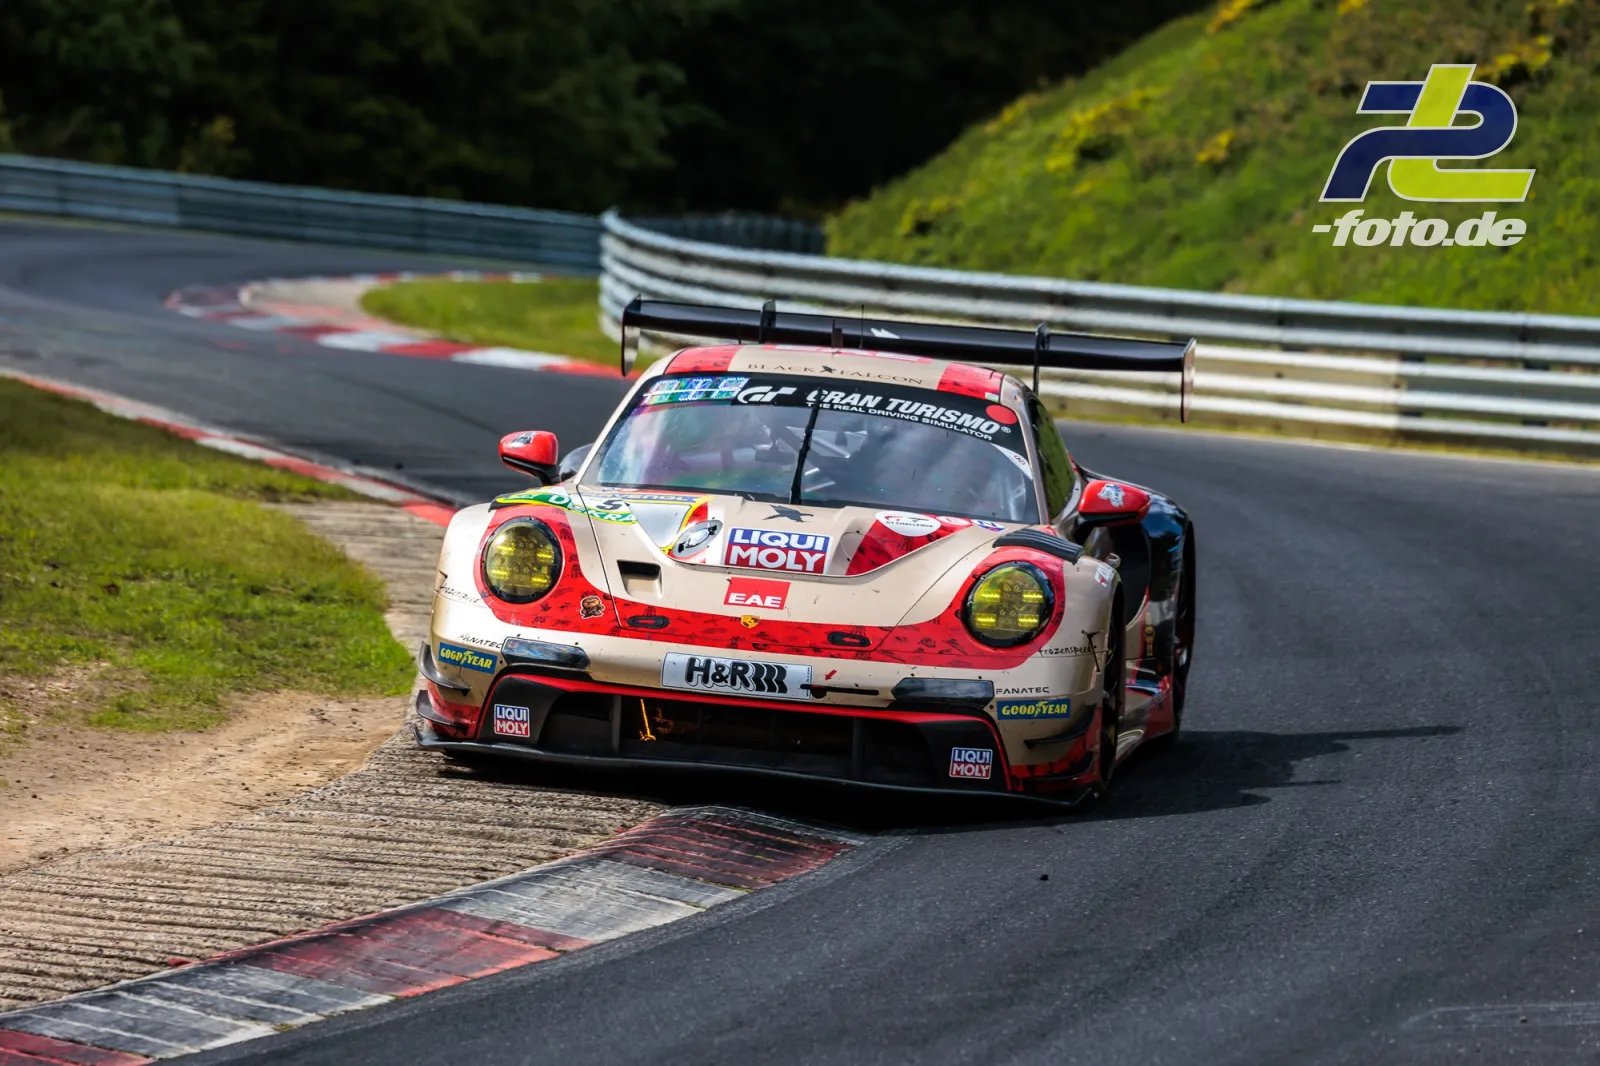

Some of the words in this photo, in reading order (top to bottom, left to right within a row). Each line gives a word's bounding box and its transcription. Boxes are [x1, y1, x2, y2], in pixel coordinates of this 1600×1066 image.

[748, 364, 815, 373] BLACK
[840, 370, 923, 385] FALCON
[737, 386, 797, 404] GT
[806, 389, 880, 407] GRAN
[833, 404, 866, 413] REAL
[868, 408, 919, 422] DRIVING
[921, 417, 992, 442] SIMULATOR
[733, 529, 825, 551] LIQUI
[729, 545, 826, 572] MOLY
[728, 592, 783, 608] EAE
[458, 633, 503, 649] FANATEC
[995, 686, 1050, 695] FANATEC
[496, 706, 528, 722] LIQUI
[496, 720, 529, 735] MOLY
[954, 749, 990, 764] LIQUI
[952, 763, 991, 777] MOLY
